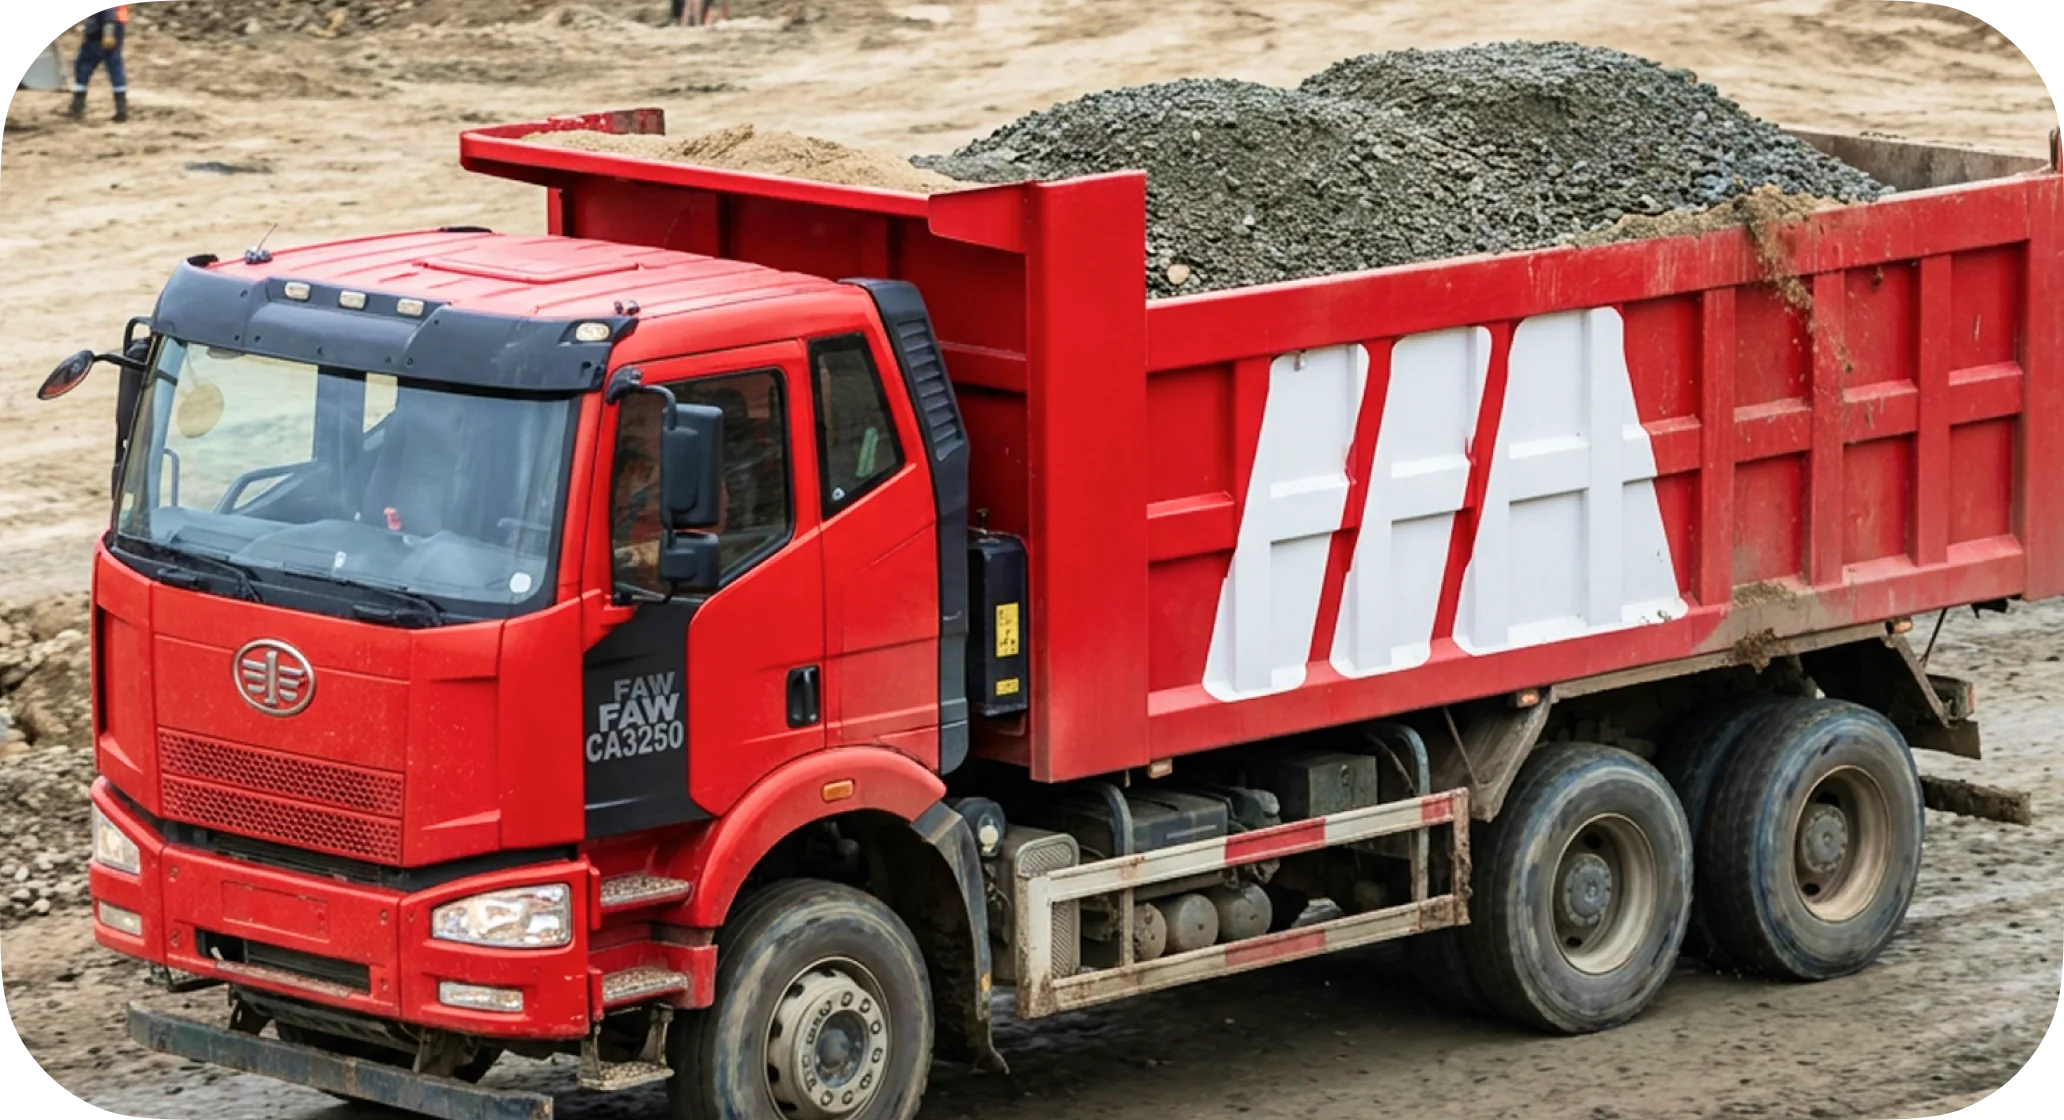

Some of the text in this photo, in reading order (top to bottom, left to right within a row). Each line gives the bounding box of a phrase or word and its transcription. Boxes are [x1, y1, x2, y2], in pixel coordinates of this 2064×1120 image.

[614, 671, 675, 702] FAW
[599, 692, 680, 732] FAW
[586, 720, 684, 762] CA3250
